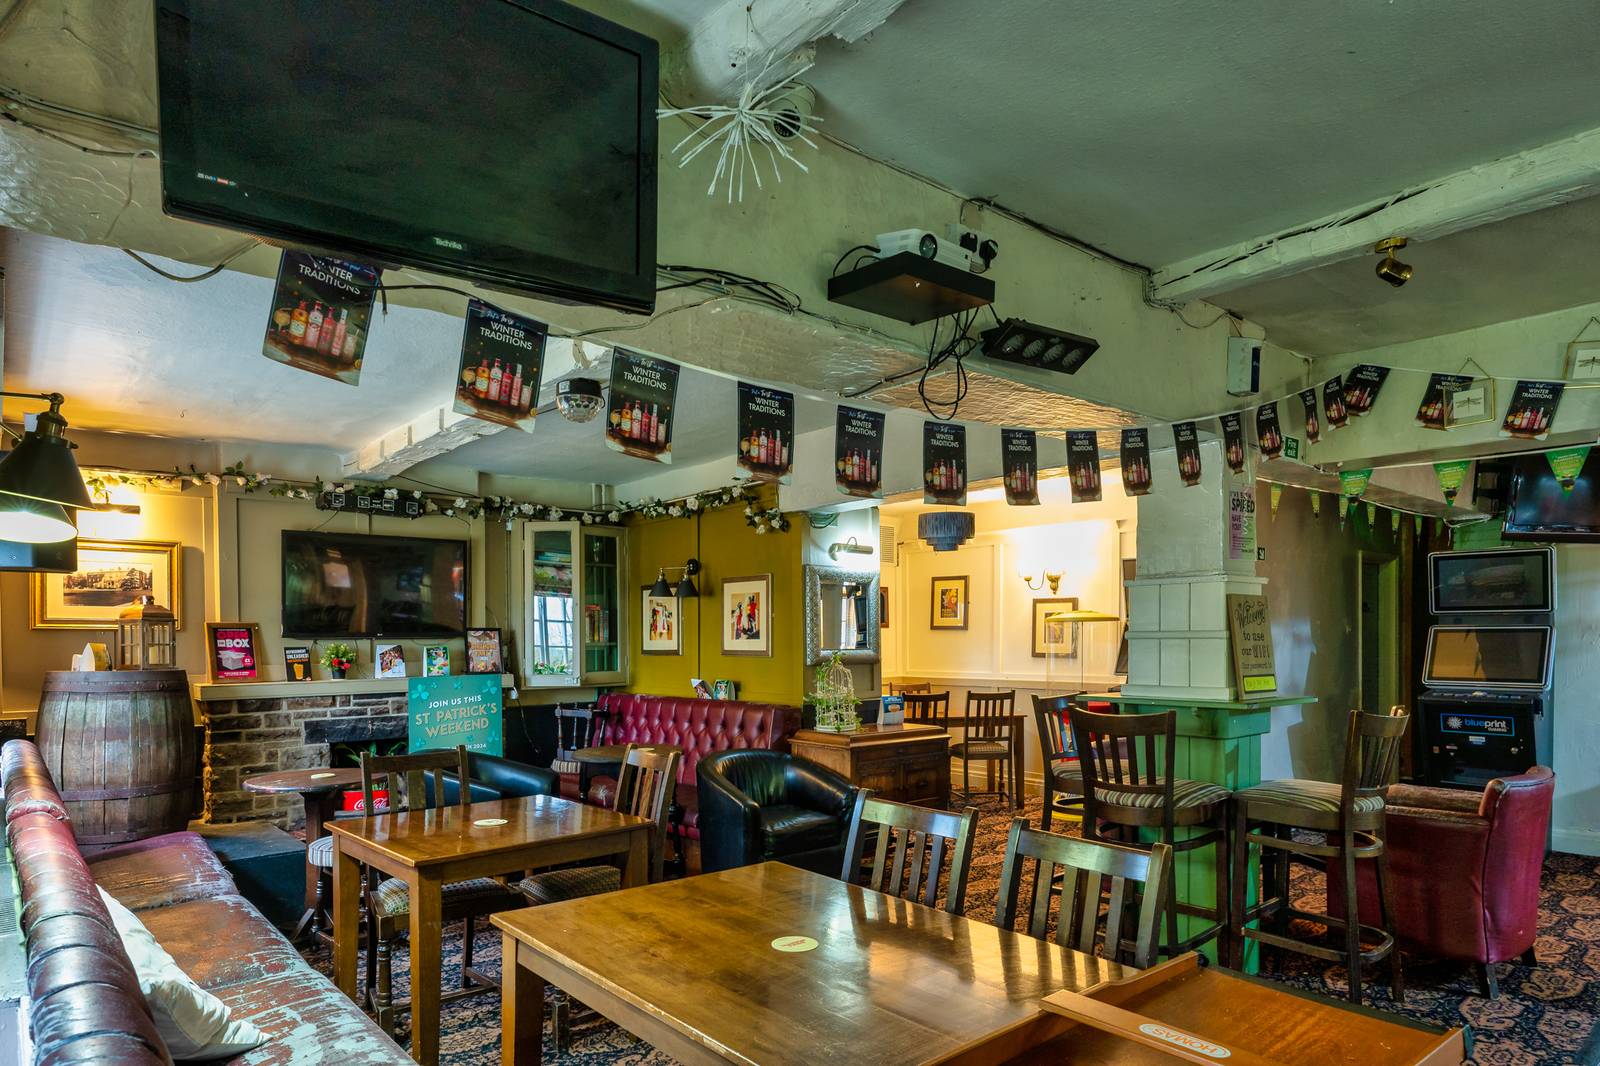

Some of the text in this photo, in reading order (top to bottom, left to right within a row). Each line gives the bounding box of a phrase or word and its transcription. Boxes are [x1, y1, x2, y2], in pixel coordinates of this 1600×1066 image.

[490, 320, 525, 339] WINTER
[480, 326, 533, 350] TRADITIONS
[632, 365, 661, 380] WINTER
[624, 372, 667, 390] TRADITIONS
[754, 396, 780, 408] WINTER
[748, 402, 786, 417] TRADITIONS
[850, 419, 872, 428] WINTER
[845, 424, 877, 438] TRADITIONS
[936, 432, 954, 440] WINTER
[930, 438, 960, 448] TRADITIONS
[226, 638, 250, 648] BOX
[1243, 632, 1250, 640] to
[1242, 648, 1252, 656] our
[428, 700, 448, 709] JOIN
[464, 695, 482, 703] THIS
[416, 703, 497, 726] ST PATRICK'S
[426, 718, 489, 738] WEEKEND
[1465, 718, 1506, 729] blueprint
